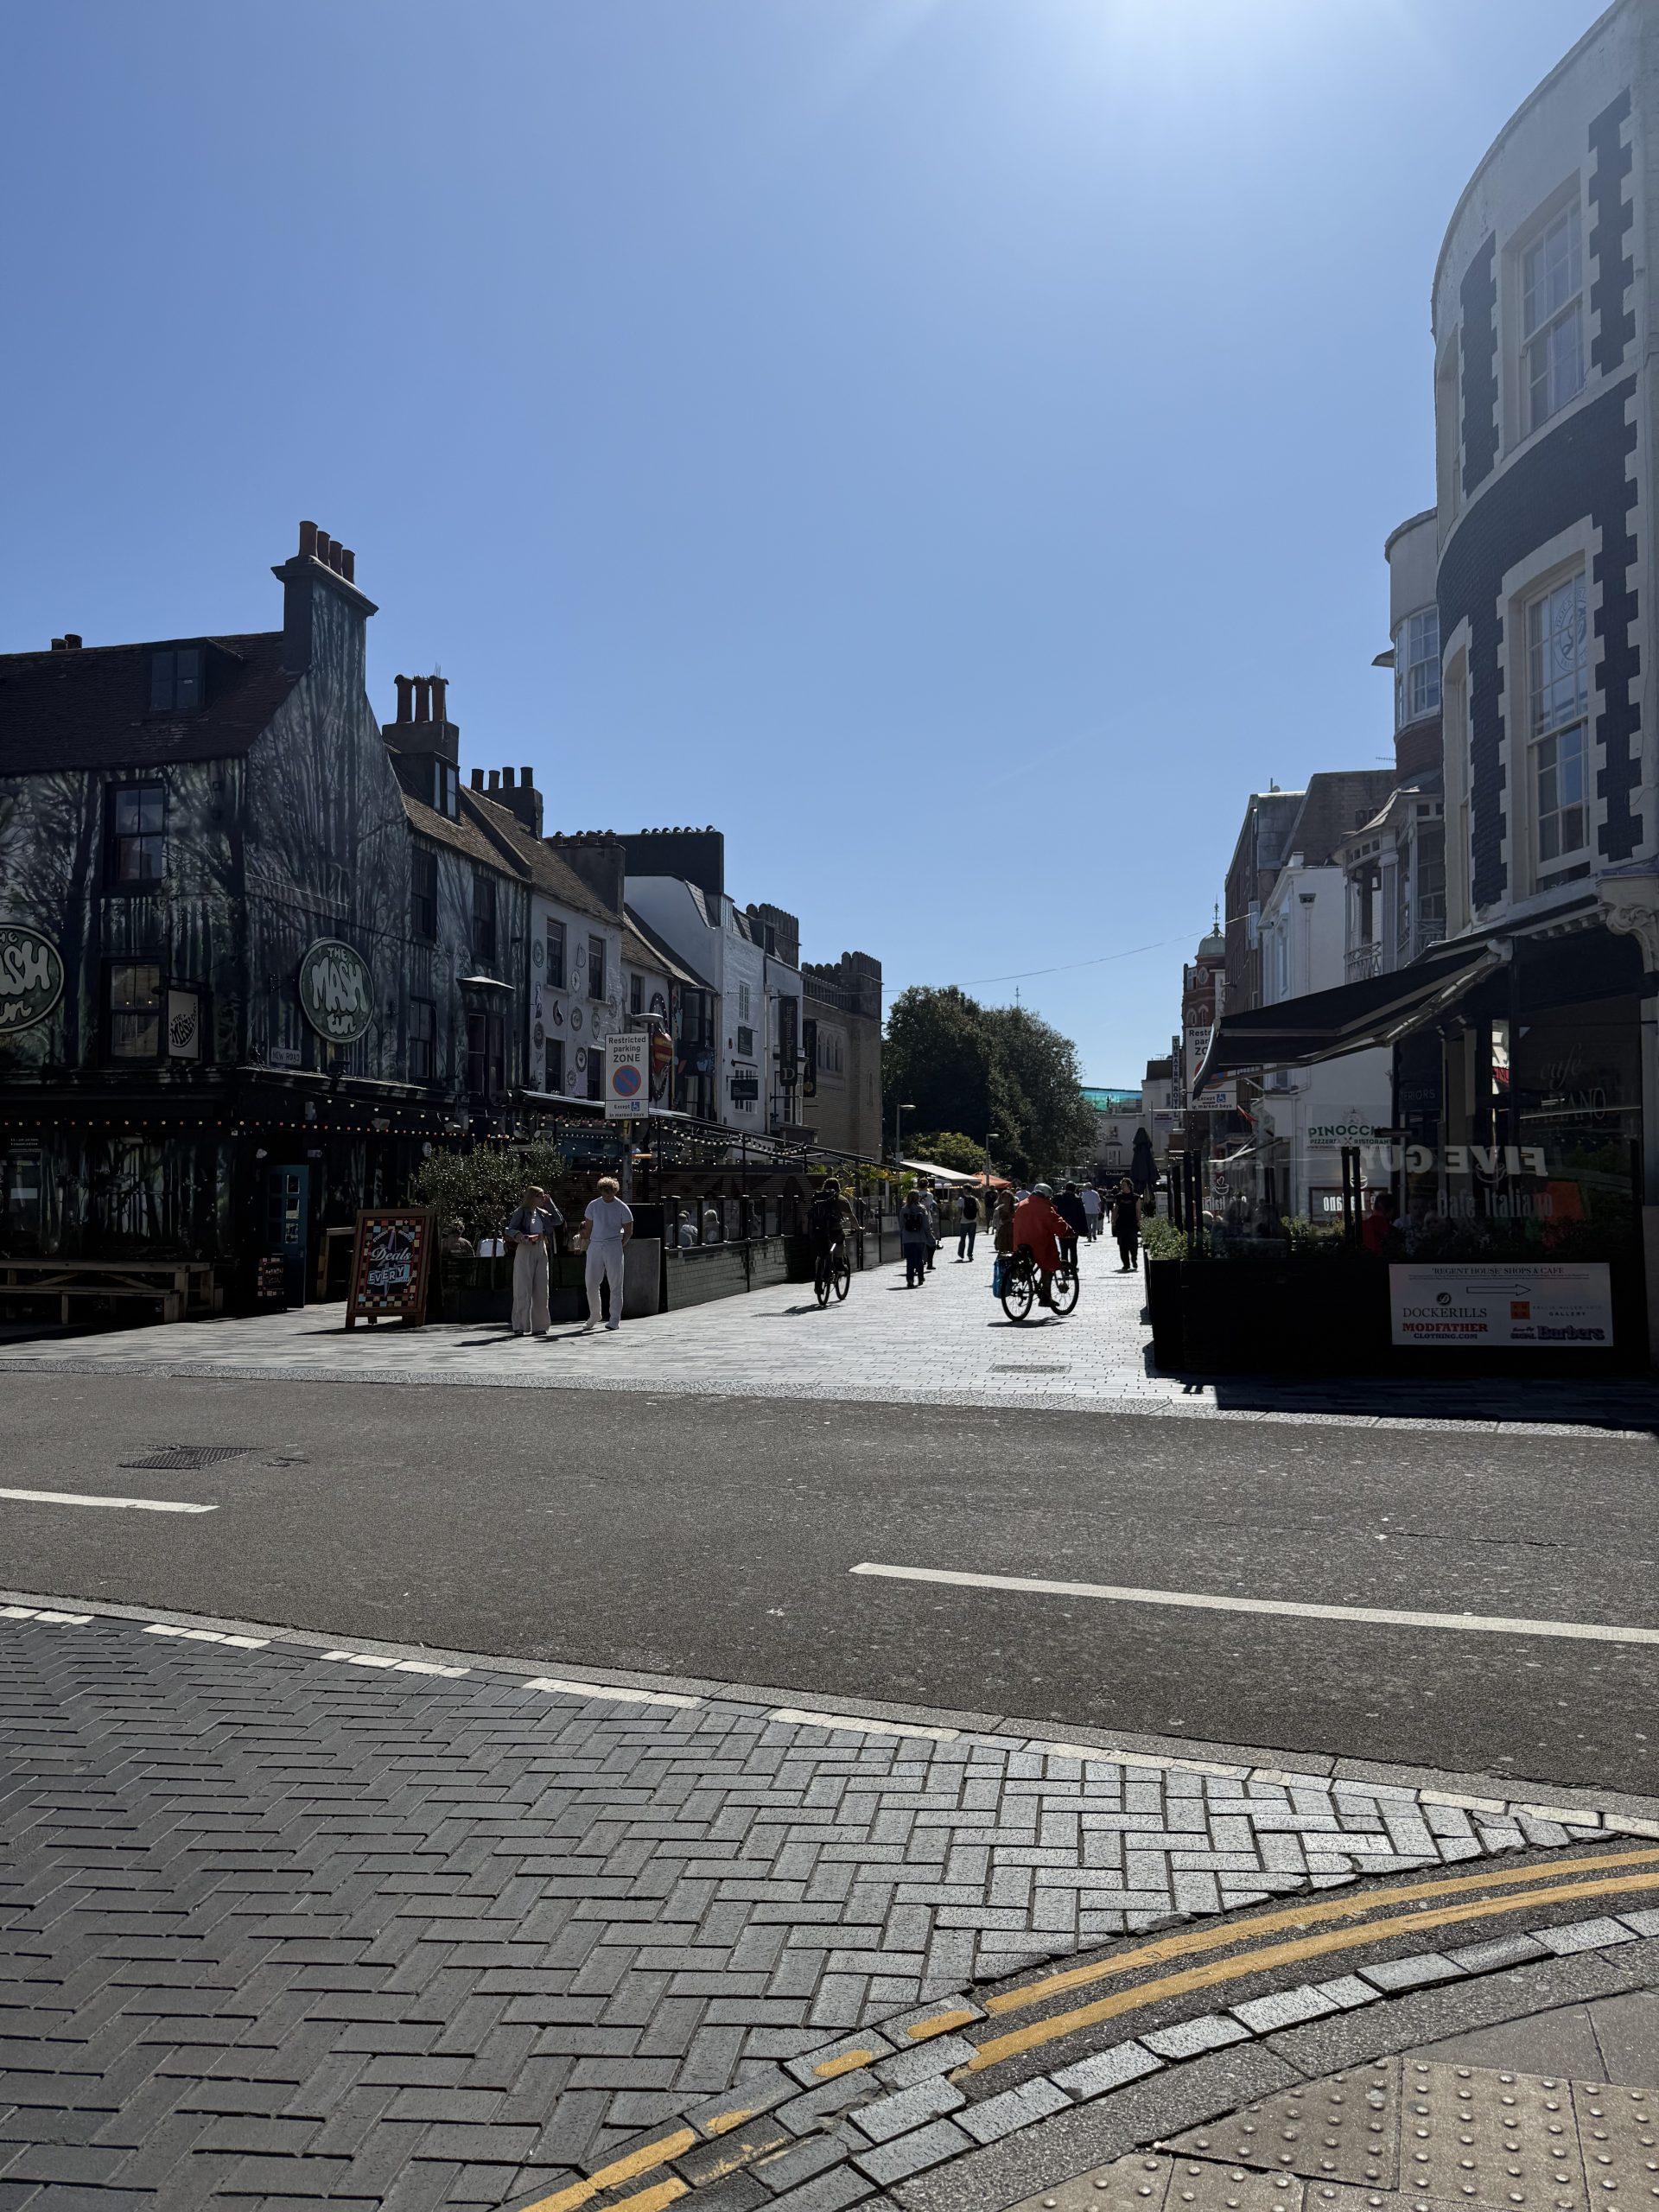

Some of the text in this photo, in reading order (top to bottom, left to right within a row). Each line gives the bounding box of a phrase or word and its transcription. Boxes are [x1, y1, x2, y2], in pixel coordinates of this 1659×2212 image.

[0, 932, 17, 943] HE
[327, 946, 347, 962] THE
[312, 957, 368, 1013] MASH
[327, 1013, 357, 1034] tun
[608, 1036, 646, 1045] Restricted
[272, 1050, 284, 1060] NEW
[613, 1054, 641, 1063] ZONE
[1484, 1187, 1554, 1217] Italiano
[370, 1247, 414, 1262] Deals
[368, 1266, 404, 1282] EVERY
[1402, 1307, 1487, 1319] DOCKERILLS
[1402, 1323, 1489, 1332] MODFATHER
